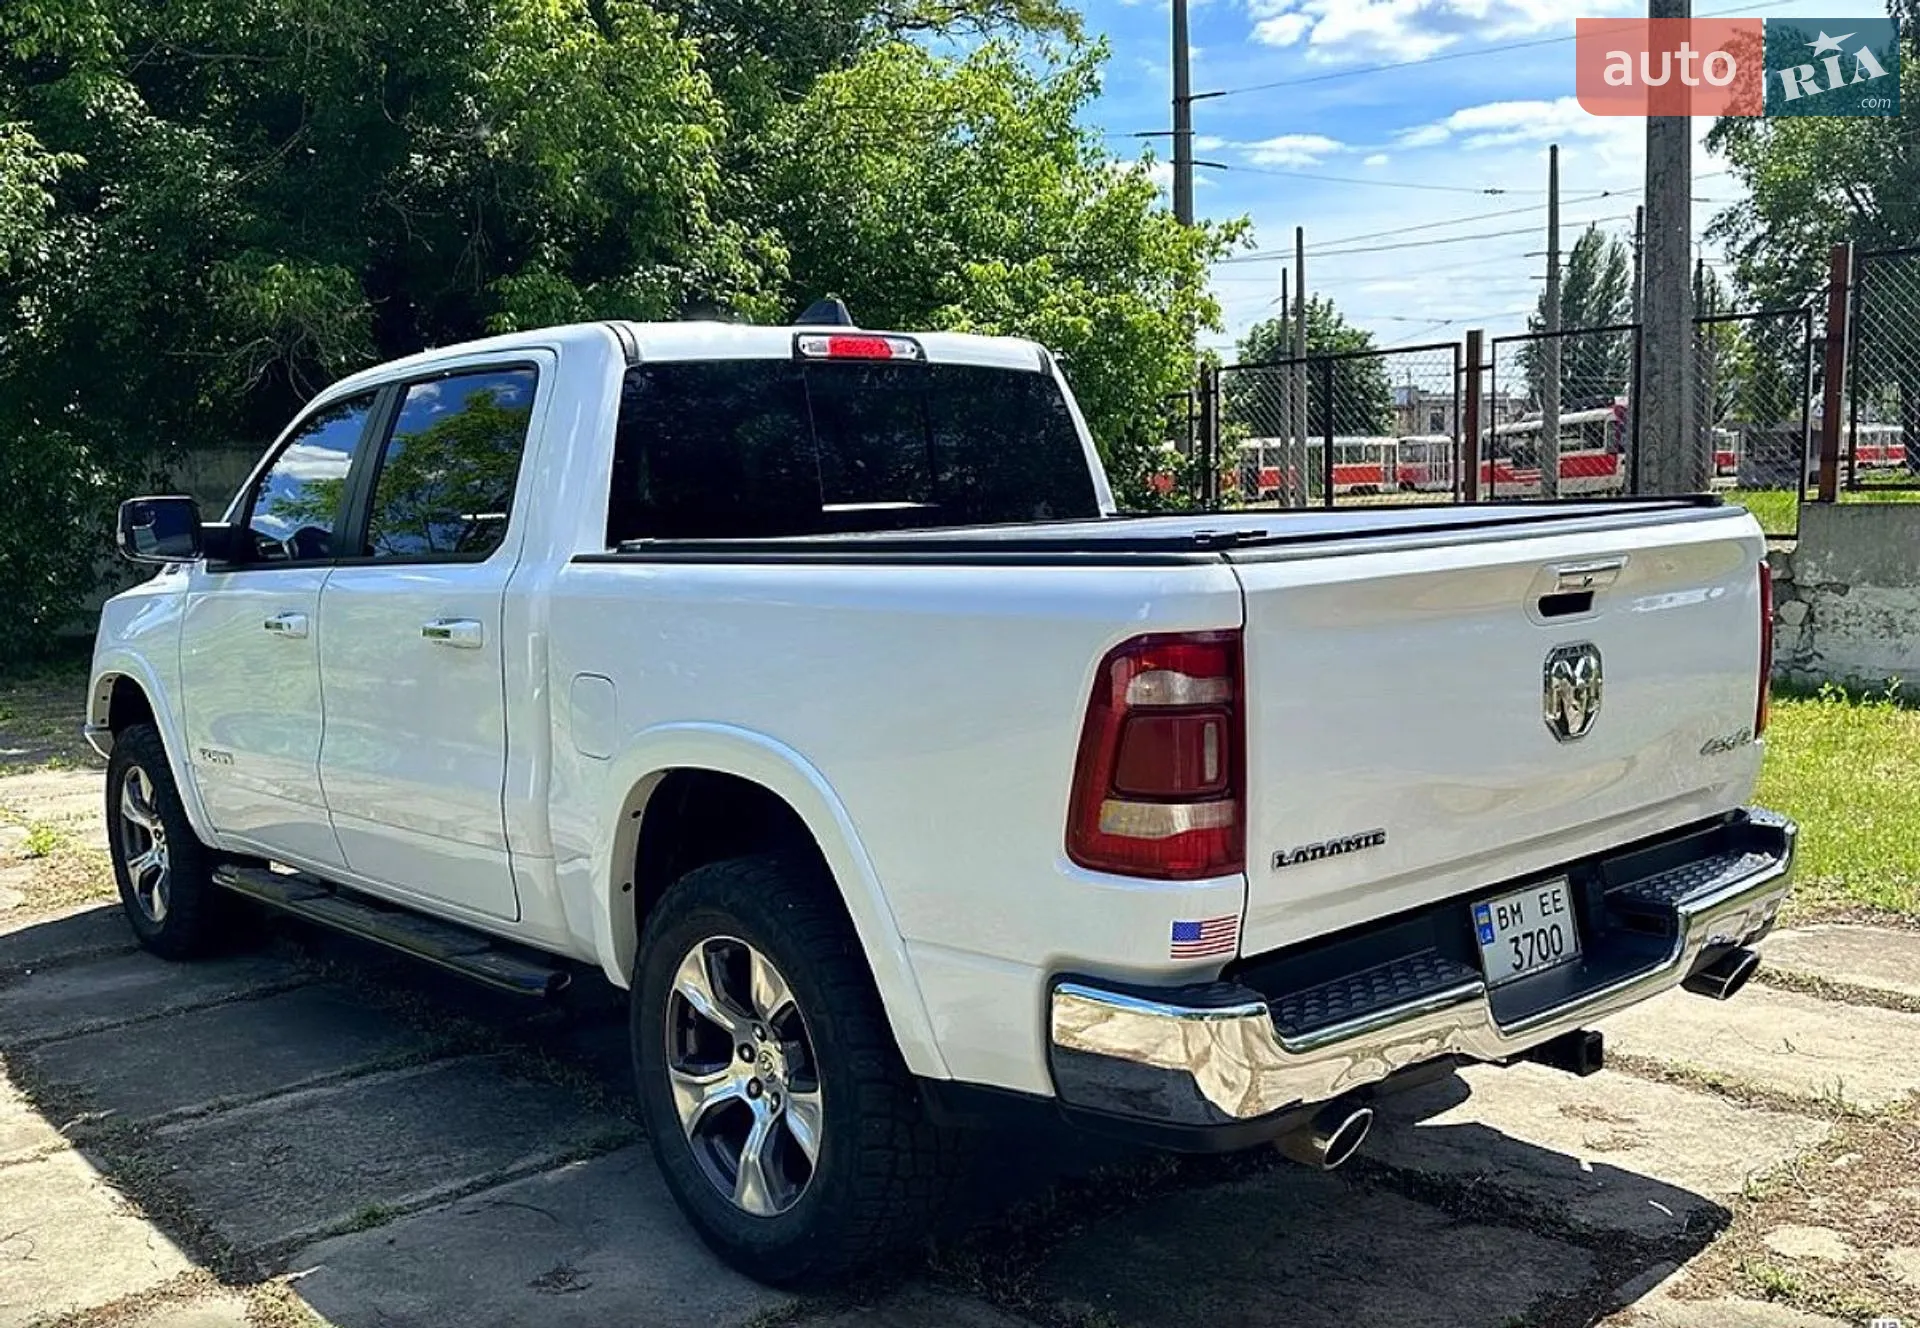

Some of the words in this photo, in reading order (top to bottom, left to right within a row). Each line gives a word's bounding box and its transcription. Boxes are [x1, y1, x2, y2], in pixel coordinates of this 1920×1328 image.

[1271, 828, 1386, 870] LARAMIE
[1497, 902, 1524, 931] BM
[1539, 888, 1564, 917] EE
[1509, 923, 1563, 970] 3700
